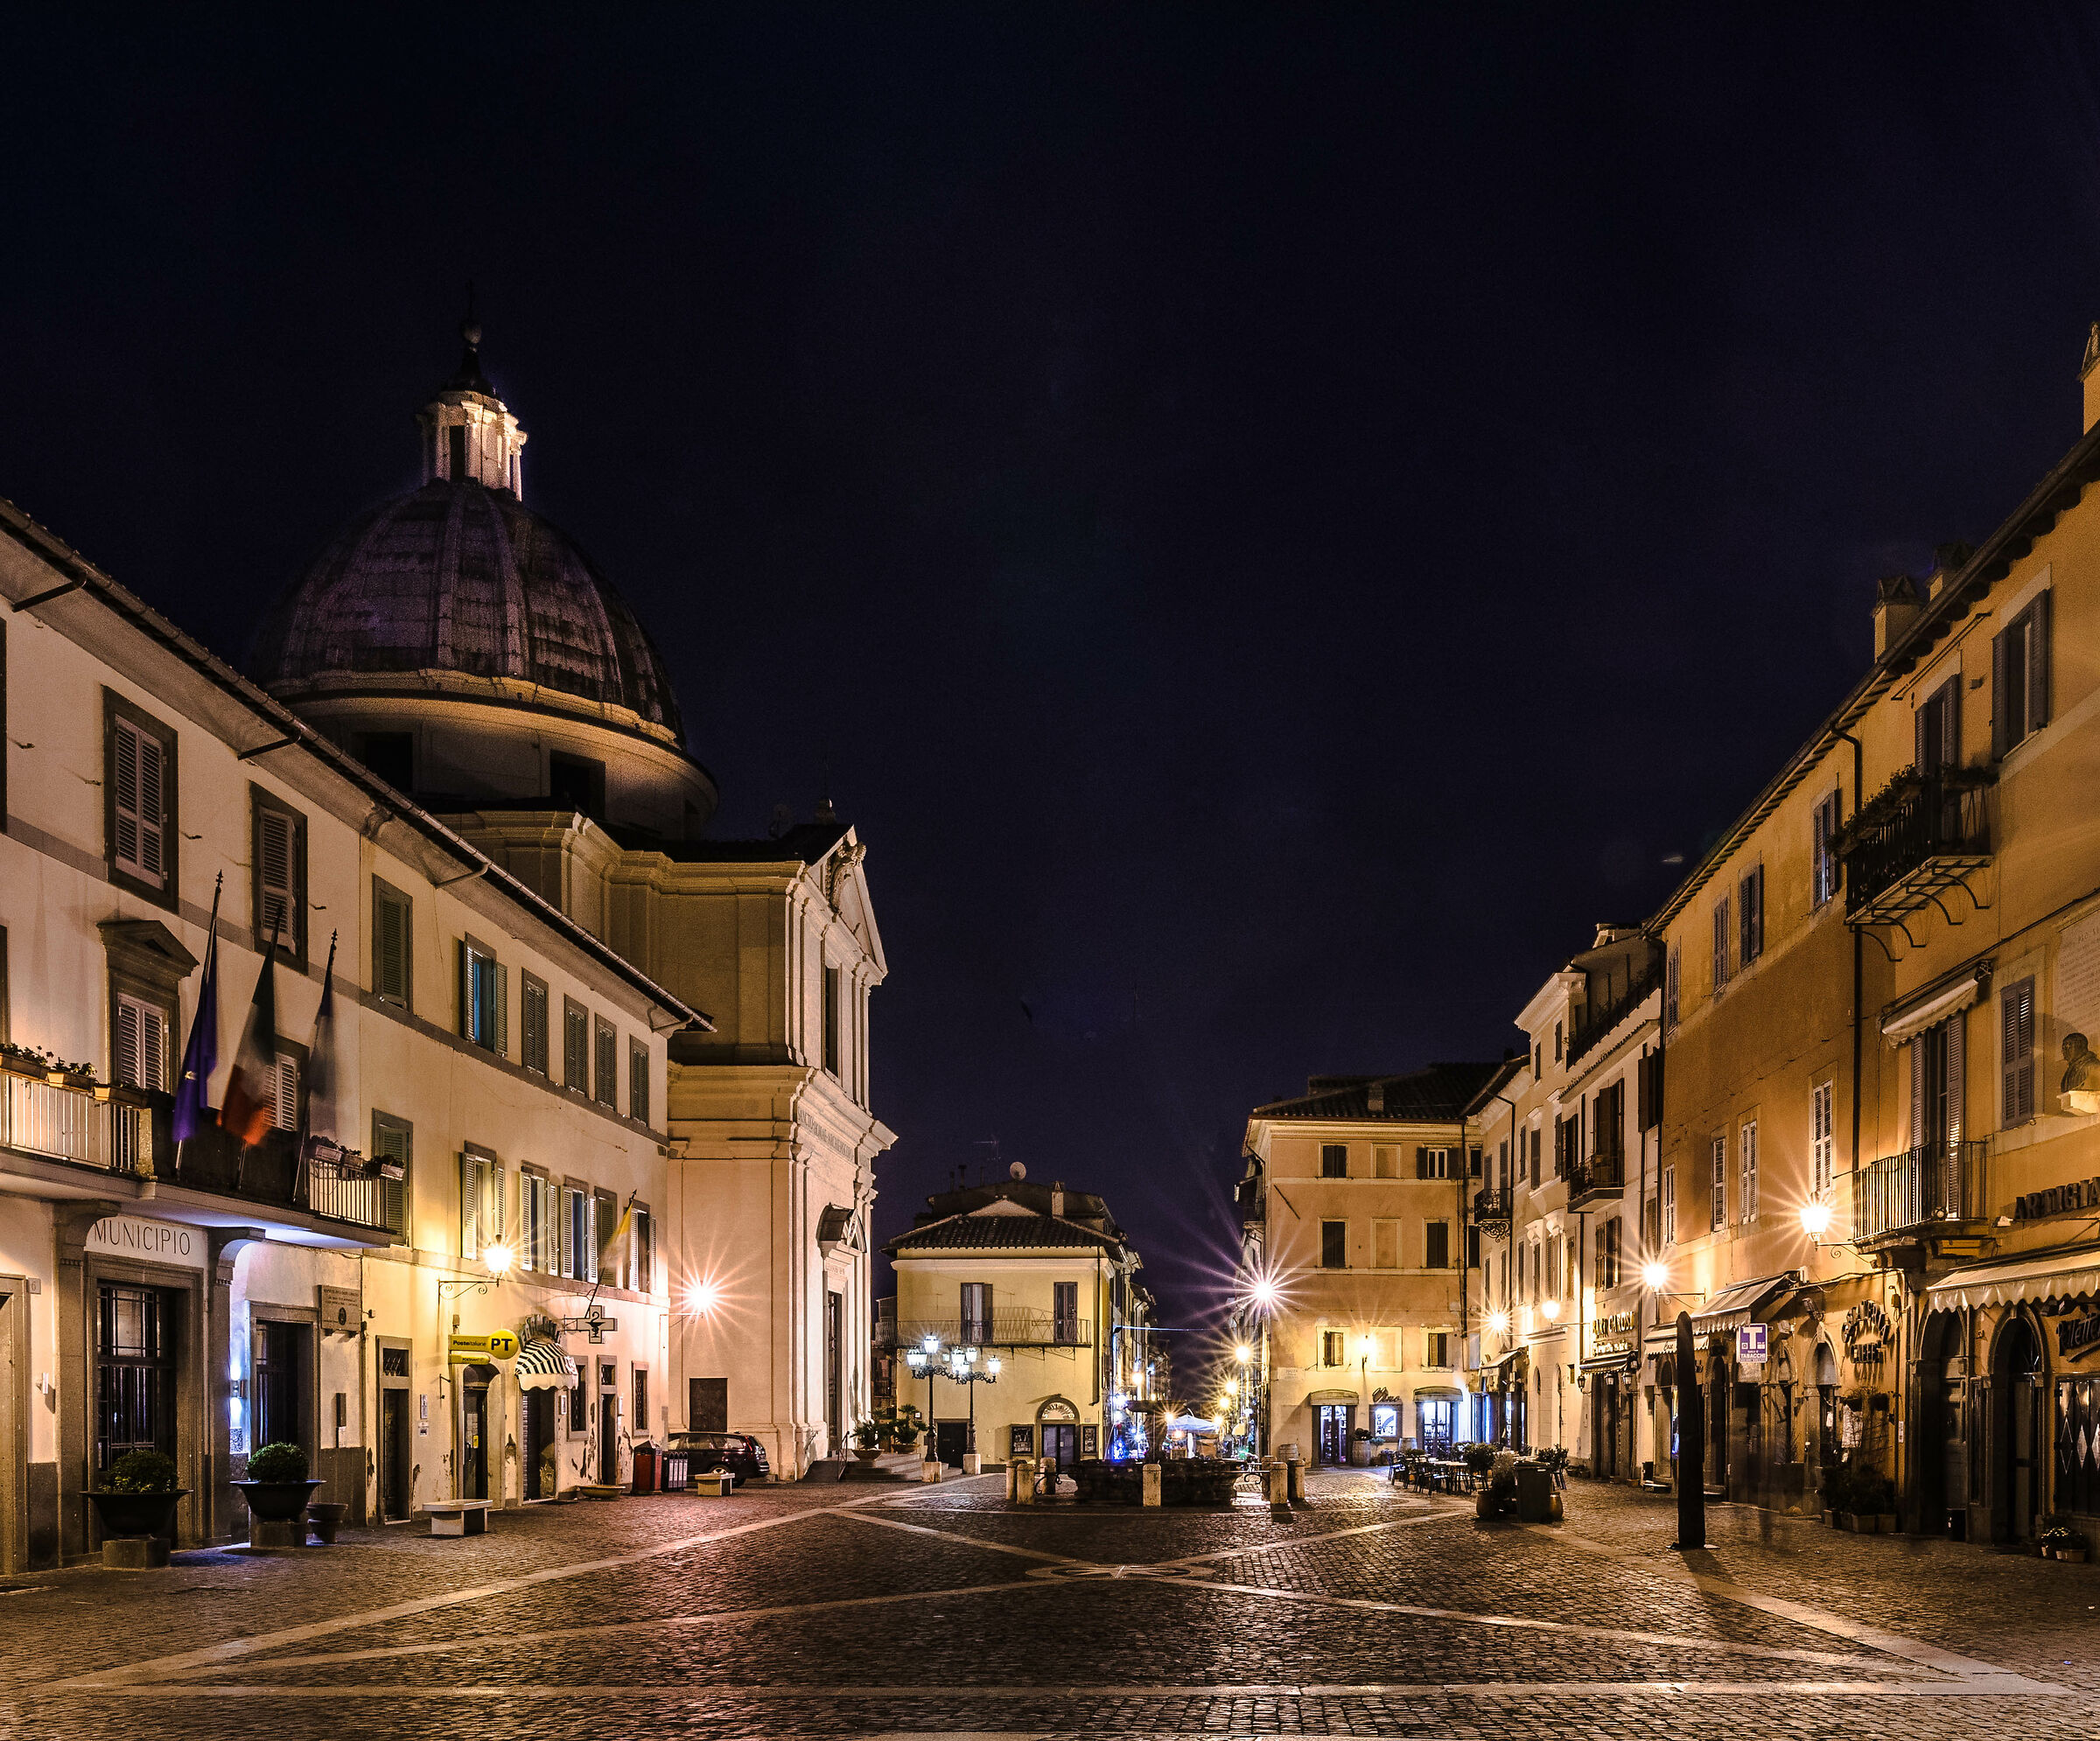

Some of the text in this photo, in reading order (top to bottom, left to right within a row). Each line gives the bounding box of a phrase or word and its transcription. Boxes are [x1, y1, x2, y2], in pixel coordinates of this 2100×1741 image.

[94, 1219, 191, 1255] MUNICIPIO
[491, 1338, 513, 1352] PT
[1743, 1326, 1763, 1350] T
